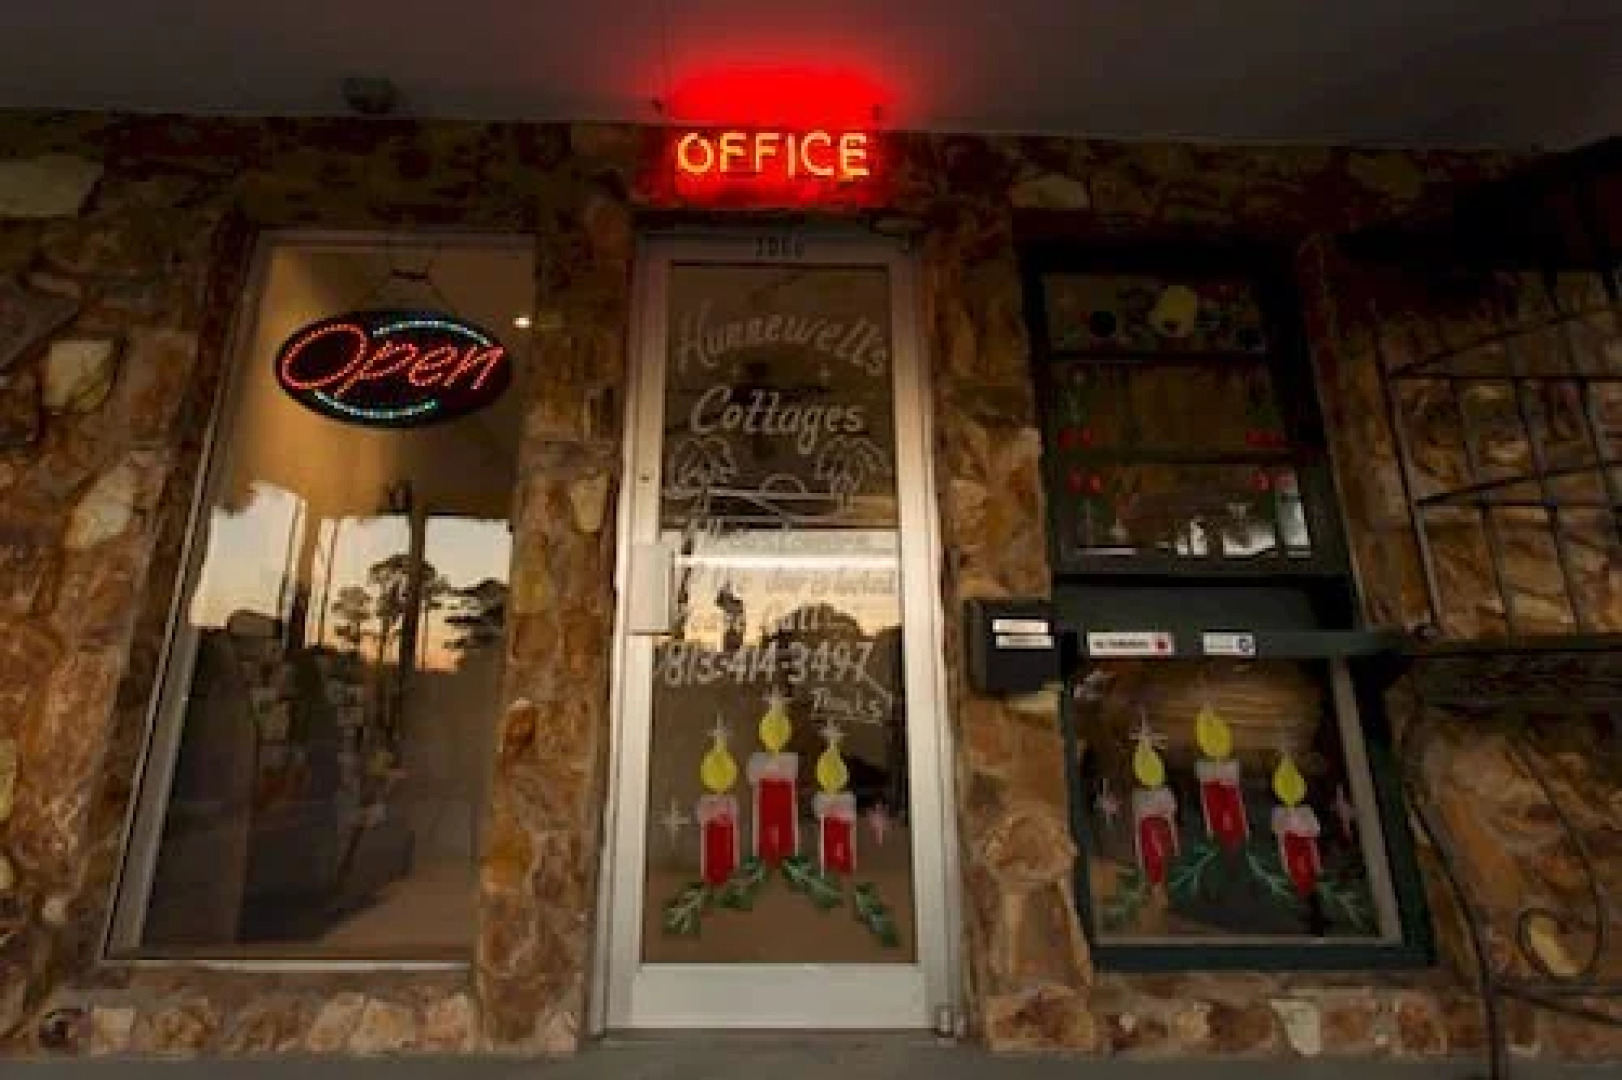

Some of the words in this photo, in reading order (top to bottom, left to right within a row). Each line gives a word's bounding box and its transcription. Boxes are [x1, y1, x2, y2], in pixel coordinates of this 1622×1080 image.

[677, 131, 870, 178] OFFICE
[281, 323, 504, 396] Open
[690, 385, 867, 455] Cottages
